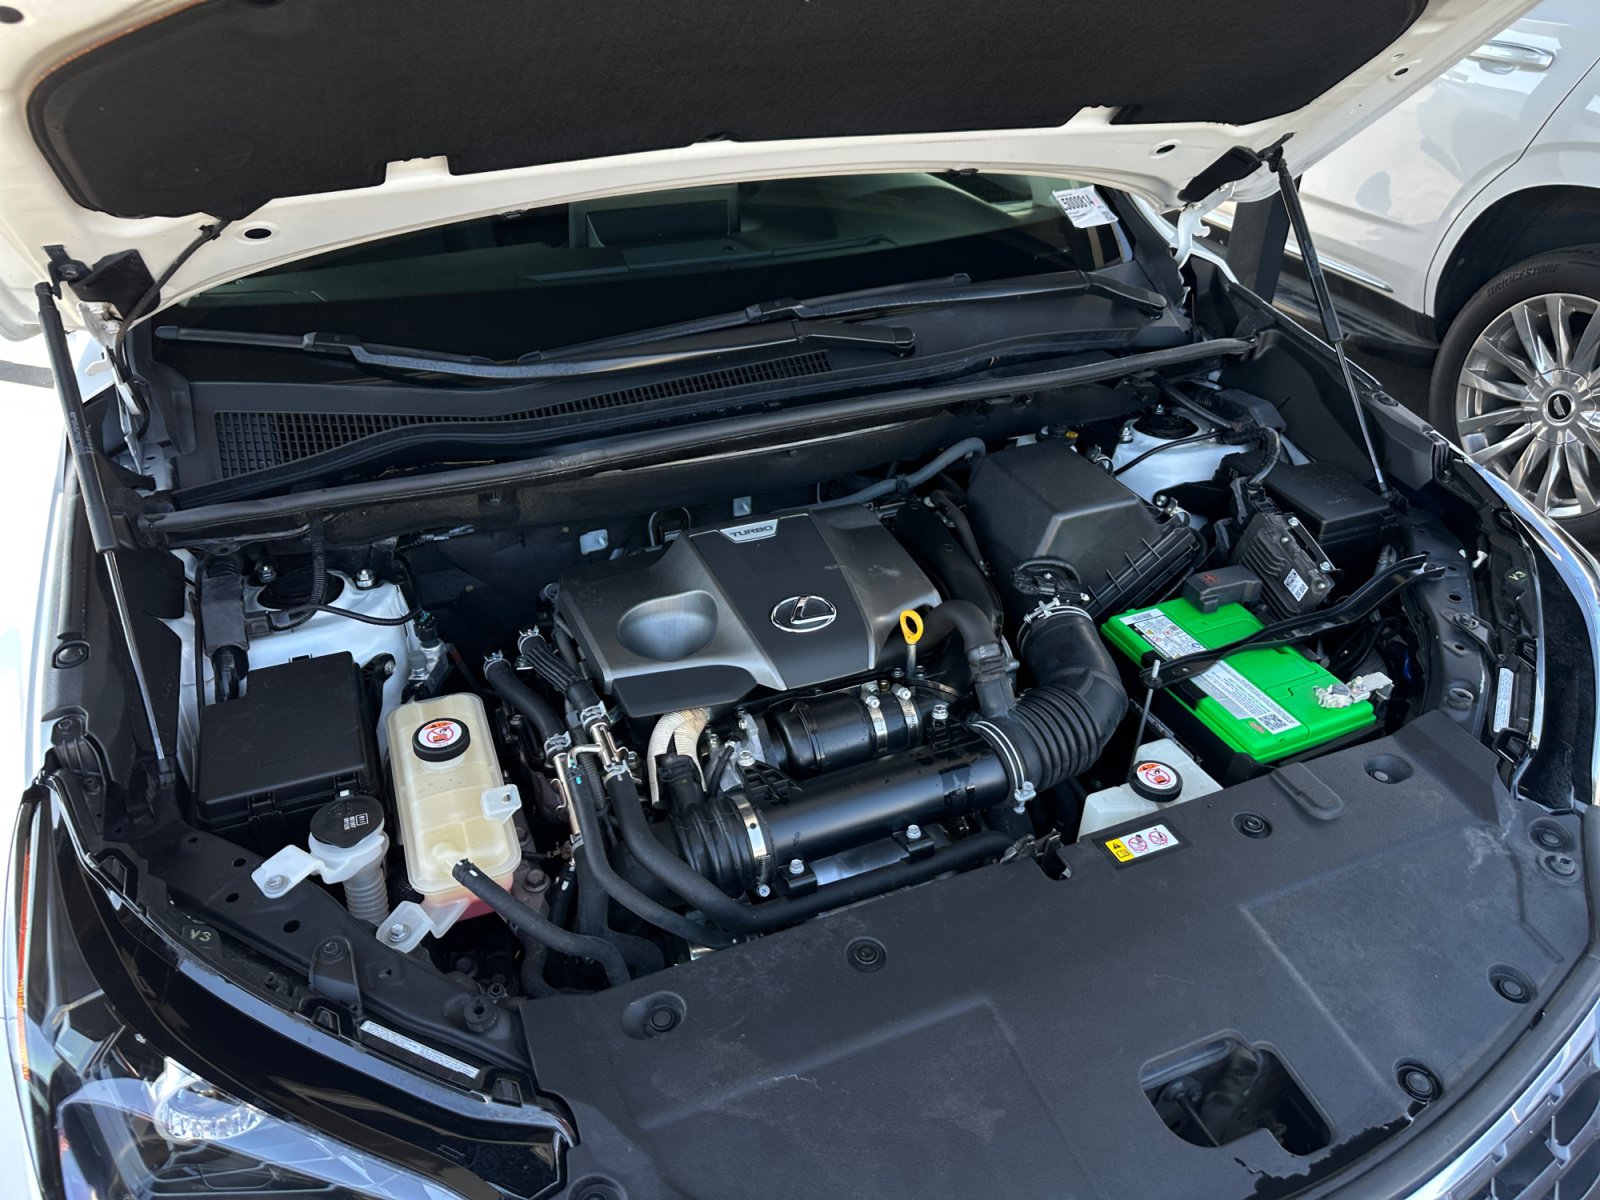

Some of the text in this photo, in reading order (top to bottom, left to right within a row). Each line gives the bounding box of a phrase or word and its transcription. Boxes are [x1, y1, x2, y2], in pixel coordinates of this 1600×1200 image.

[1486, 263, 1562, 298] BRIDGESTONE
[729, 525, 774, 537] TURBO
[189, 928, 212, 942] V3
